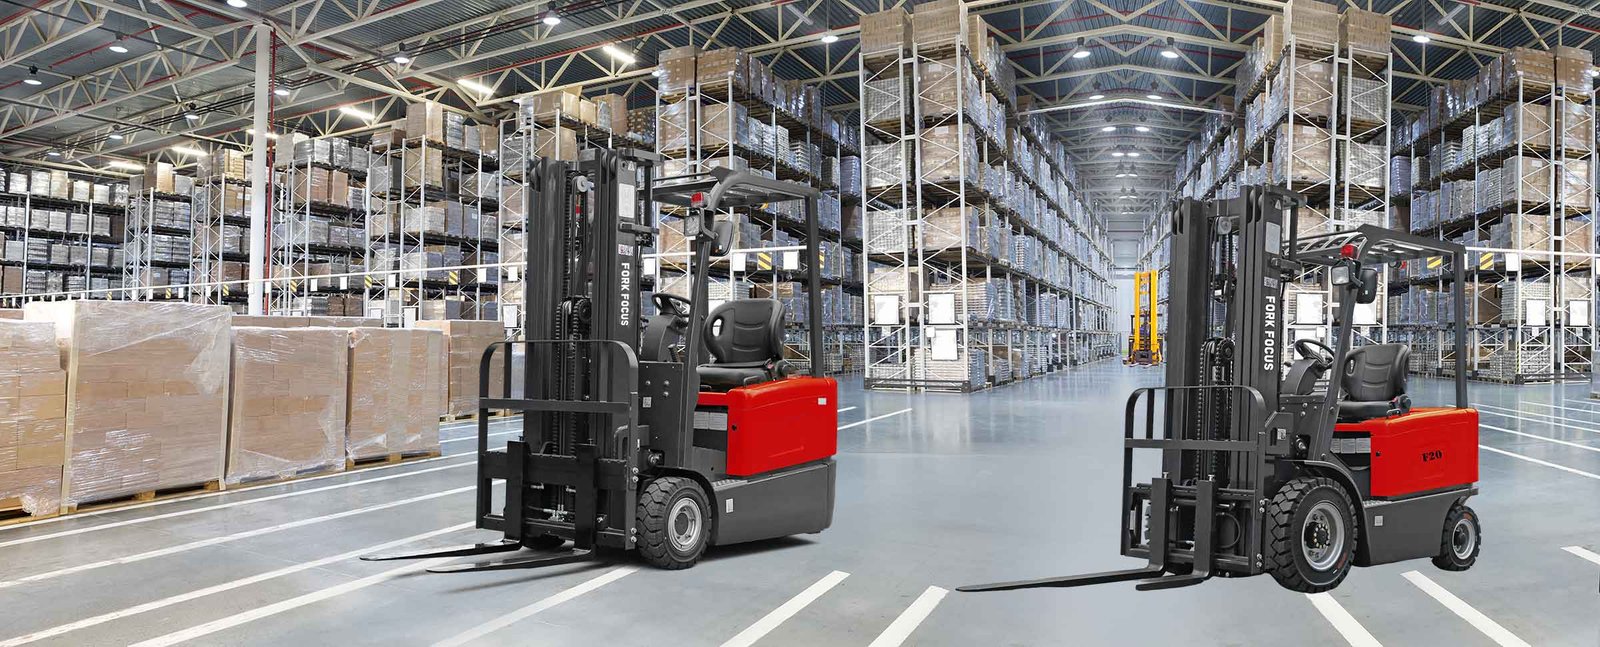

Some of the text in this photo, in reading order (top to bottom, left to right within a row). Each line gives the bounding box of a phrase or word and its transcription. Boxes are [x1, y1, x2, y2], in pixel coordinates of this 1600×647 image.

[620, 262, 630, 326] FORK FOCUS
[1263, 295, 1276, 371] FORK FOCUS
[1422, 449, 1442, 462] F20
